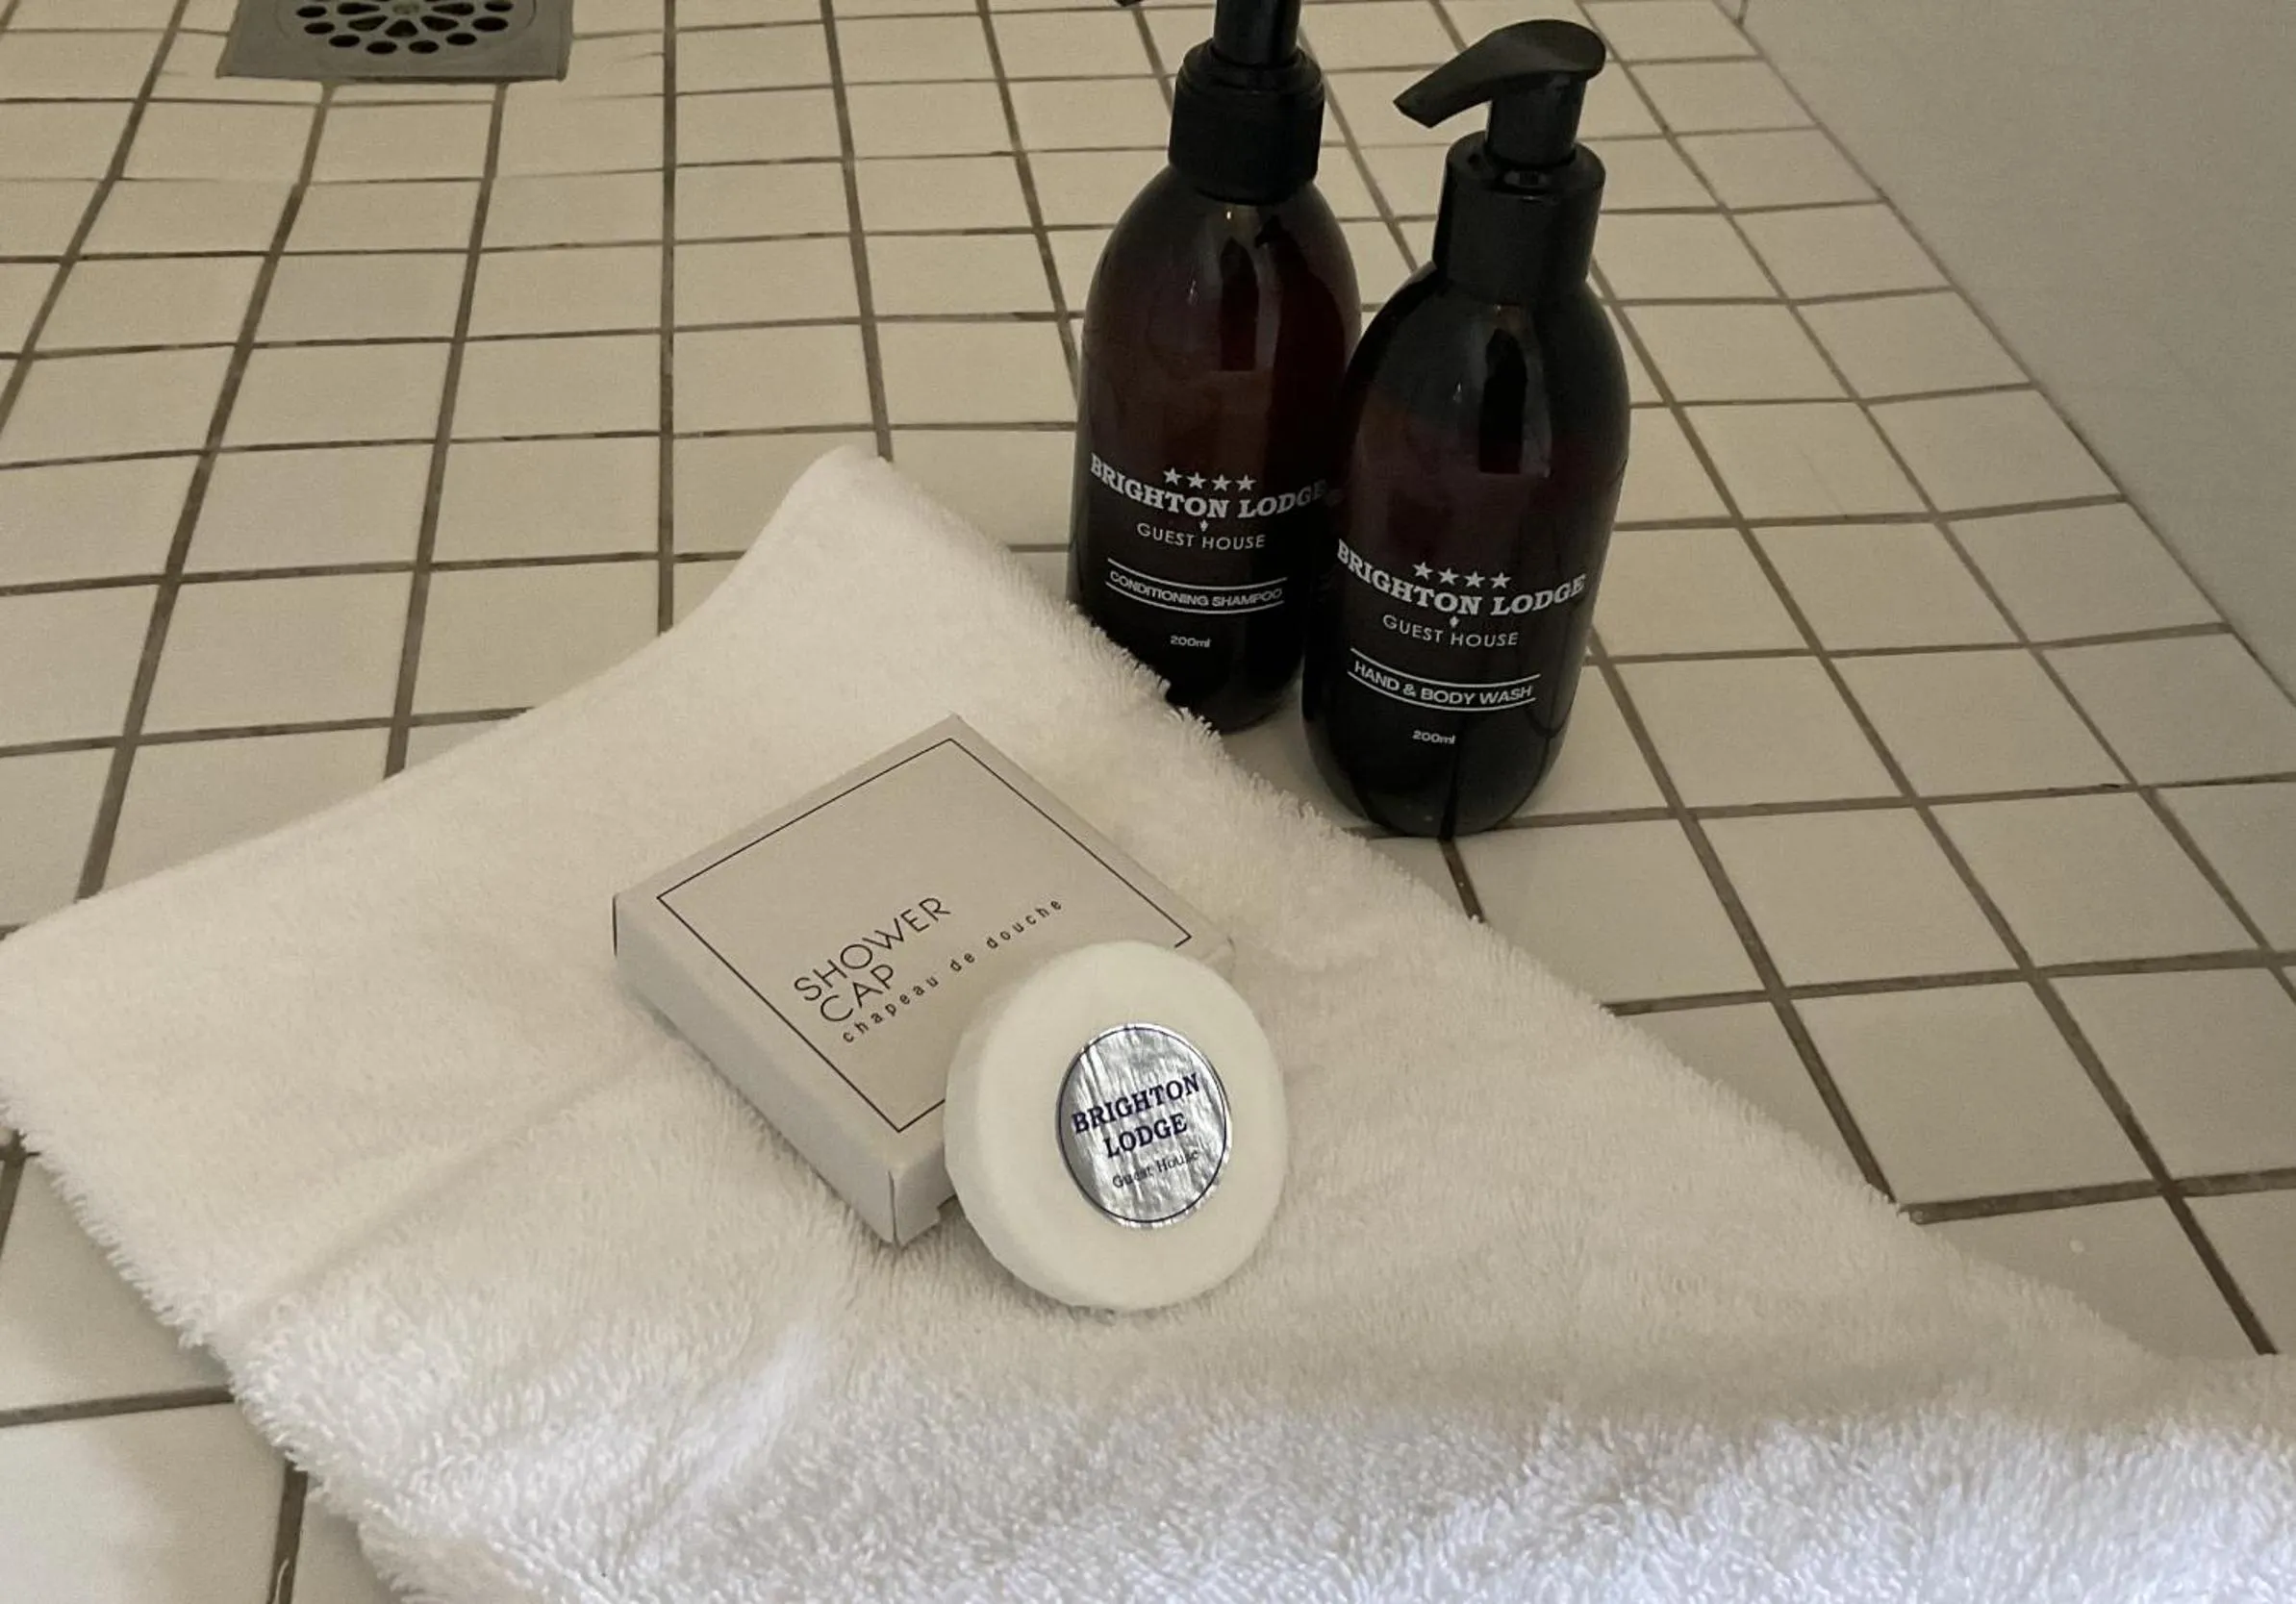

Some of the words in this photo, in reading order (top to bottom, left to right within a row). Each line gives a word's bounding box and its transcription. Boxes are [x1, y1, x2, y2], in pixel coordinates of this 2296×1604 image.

[1091, 452, 1230, 518] BRIGHTON
[1237, 480, 1328, 518] LODGE
[1136, 522, 1195, 547] GUEST
[1202, 534, 1266, 551] HOUSE
[1110, 570, 1209, 607] CONDITIONING
[1212, 588, 1283, 608] SHAMPOO
[1337, 539, 1483, 615] BRIGHTON
[1491, 573, 1587, 616] LODGE
[1170, 635, 1211, 648] 200ml
[1382, 614, 1443, 643] GUEST
[1450, 631, 1519, 647] HOUSE
[1354, 660, 1400, 691] HAND
[1402, 683, 1417, 696] &
[1420, 688, 1475, 705] BODY
[1479, 685, 1532, 705] WASH
[1412, 730, 1456, 745] 200ml
[794, 897, 951, 1002] SHOWER
[843, 976, 939, 1043] chapeau
[949, 952, 975, 973] de
[986, 898, 1062, 949] douche
[820, 964, 895, 1023] CAP
[1072, 1072, 1200, 1135] BRIGHTON
[1103, 1112, 1188, 1159] LODGE
